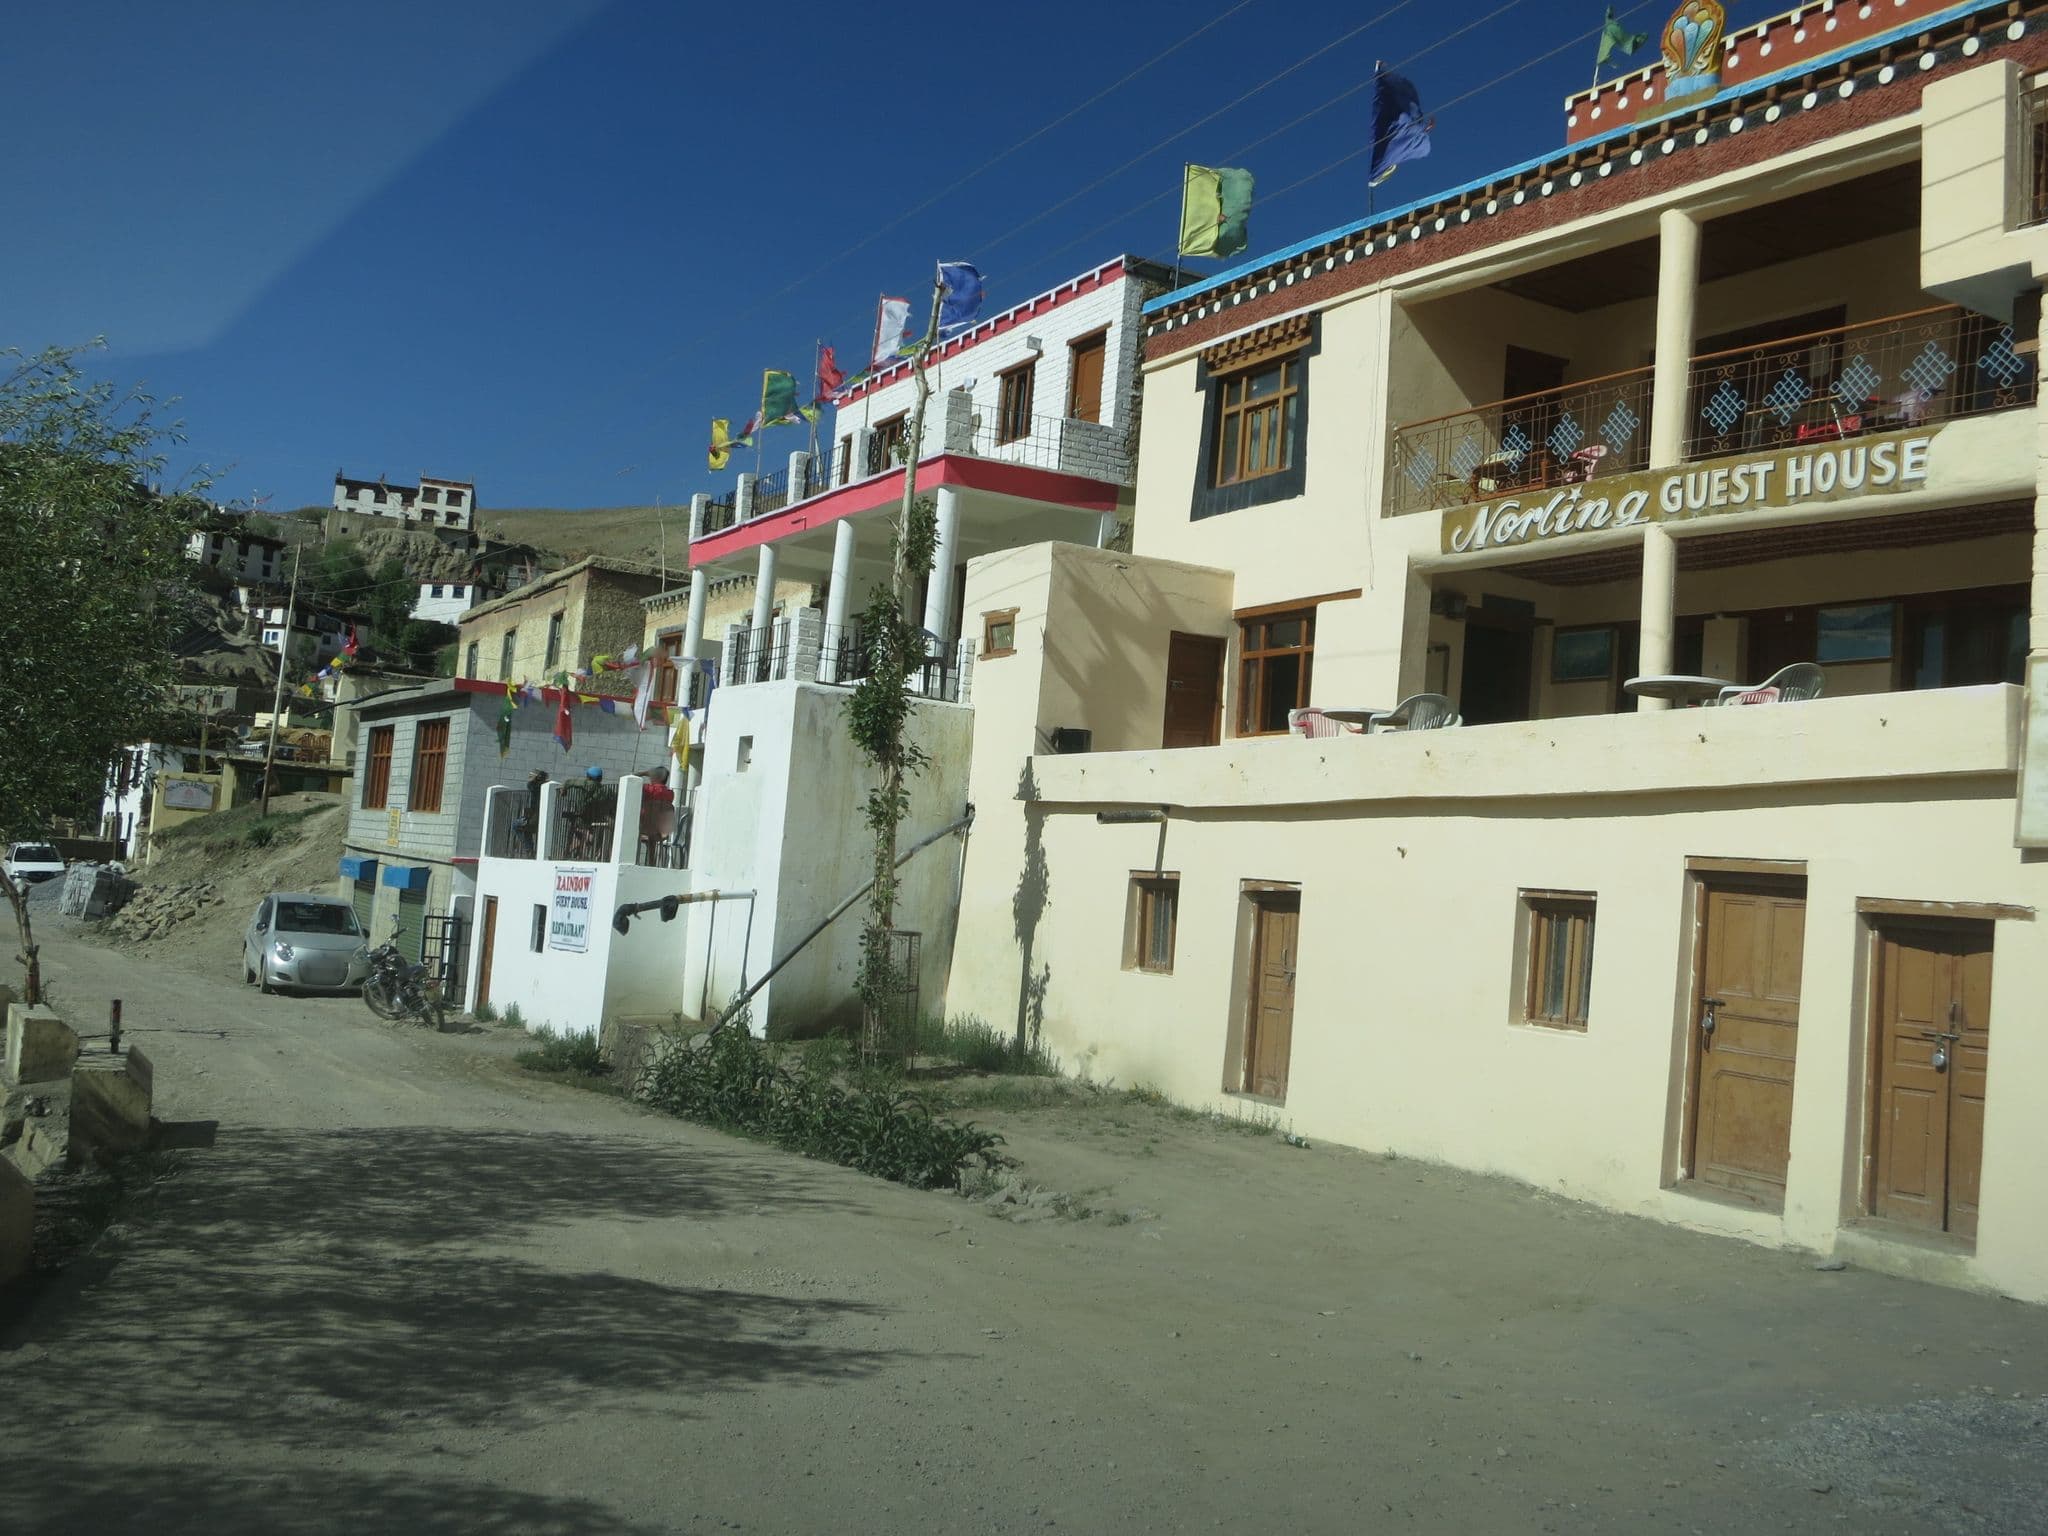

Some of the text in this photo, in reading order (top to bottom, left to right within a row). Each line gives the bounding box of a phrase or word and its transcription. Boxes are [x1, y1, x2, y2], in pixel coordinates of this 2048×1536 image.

[1452, 437, 1929, 552] Norling GUEST HOUSE
[556, 876, 592, 892] RAINBOW
[555, 895, 588, 909] GUEST HOUSE
[552, 921, 585, 938] RESTAURANT
